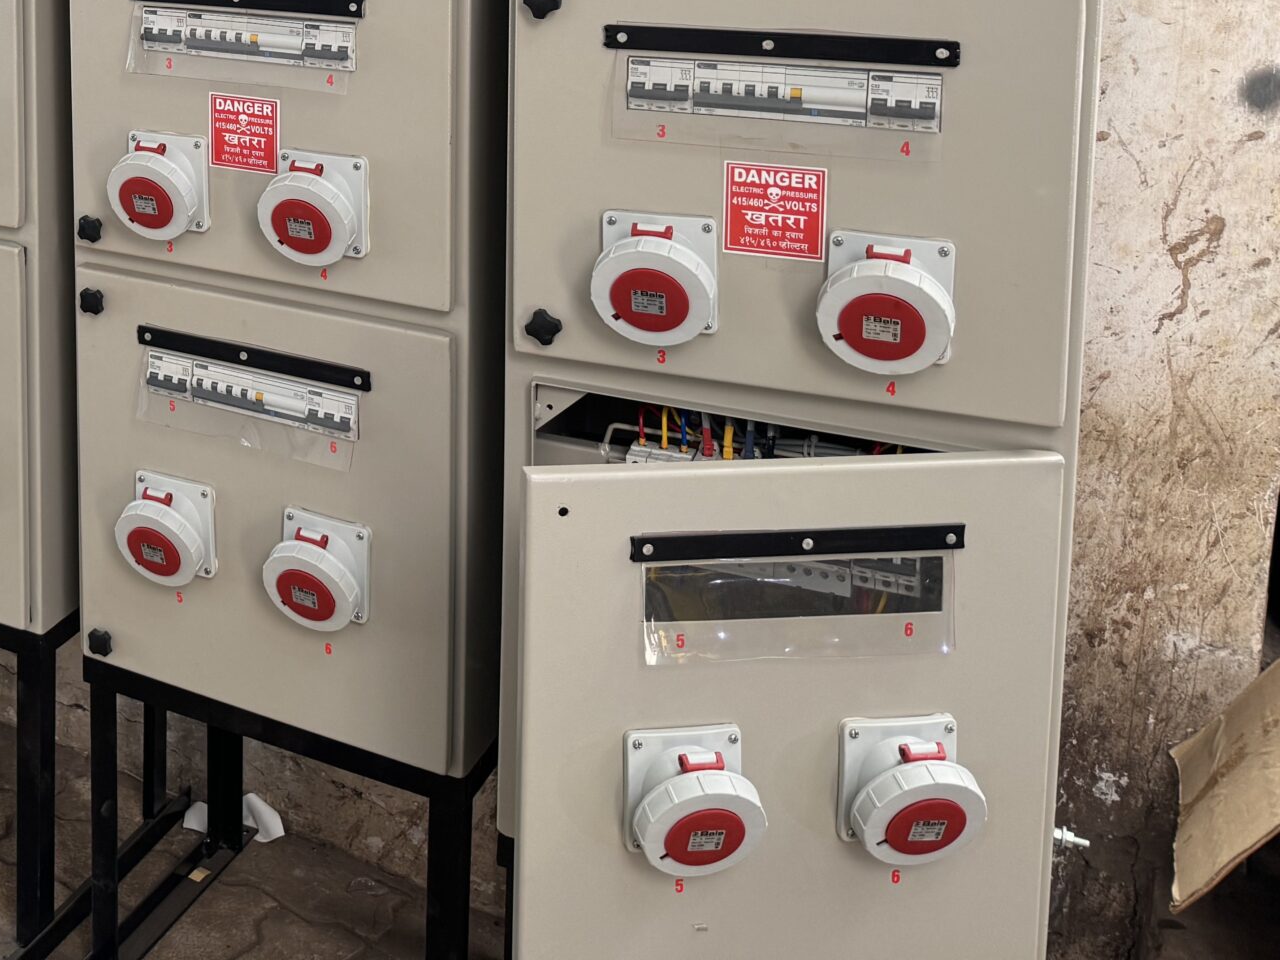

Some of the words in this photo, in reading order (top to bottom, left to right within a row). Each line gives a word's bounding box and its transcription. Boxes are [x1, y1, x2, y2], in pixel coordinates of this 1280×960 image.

[166, 58, 173, 69] 3
[326, 74, 334, 87] 4
[216, 98, 272, 116] DANGER
[250, 126, 273, 135] VOLTS
[222, 132, 267, 148] खतरा
[656, 124, 666, 138] 3
[900, 141, 910, 157] 4
[734, 167, 817, 189] DANGER
[732, 186, 764, 194] ELECTRIC
[781, 190, 818, 199] PRESSURE
[732, 196, 763, 207] 415/460
[785, 200, 817, 212] VOLTS
[741, 210, 808, 229] खतरा
[167, 241, 173, 253] 3
[321, 268, 328, 280] 4
[657, 349, 666, 364] 3
[886, 381, 896, 396] 4
[169, 400, 176, 412] 5
[330, 442, 337, 453] 6
[176, 591, 183, 603] 5
[676, 634, 685, 648] 5
[904, 622, 913, 636] 6
[324, 643, 332, 655] 6
[891, 869, 900, 884] 6
[675, 879, 684, 893] 5
